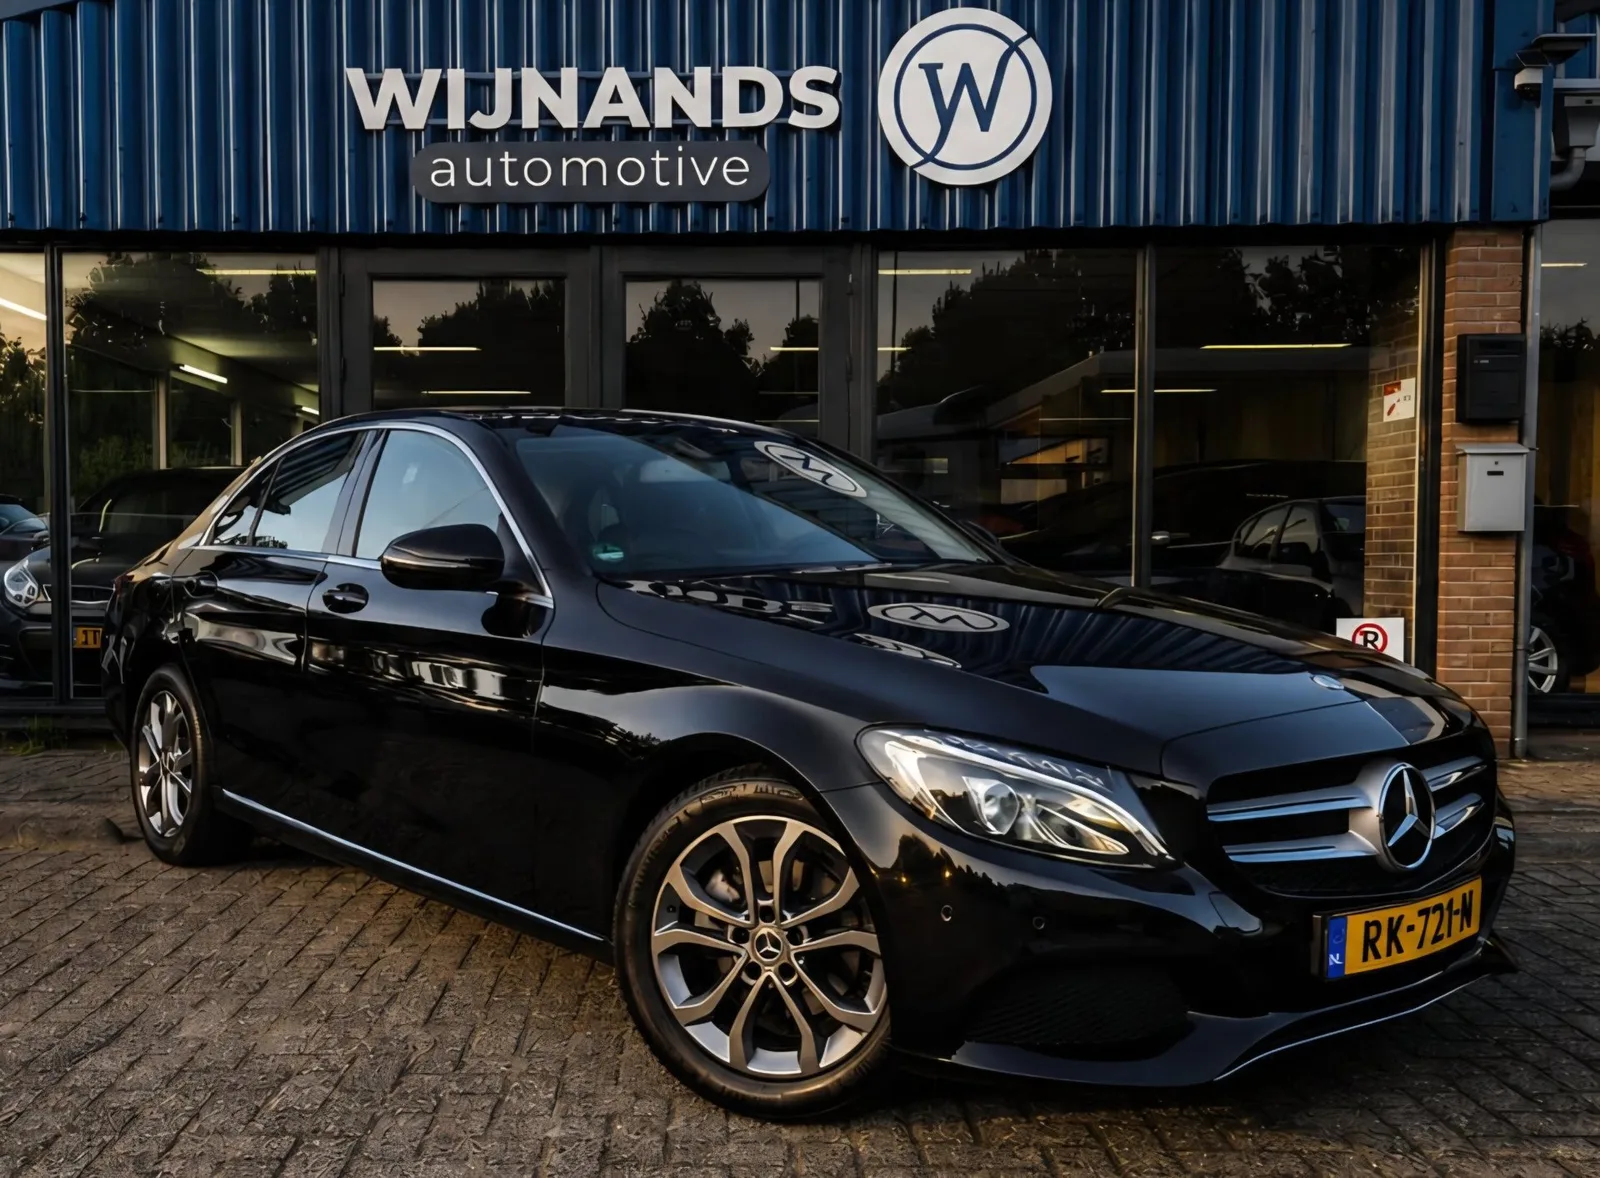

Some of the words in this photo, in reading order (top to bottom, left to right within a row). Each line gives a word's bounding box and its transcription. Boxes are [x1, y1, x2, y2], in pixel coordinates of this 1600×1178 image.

[346, 65, 841, 130] WIJNANDS
[430, 146, 751, 188] automotive
[1362, 889, 1474, 963] RK-721-N
